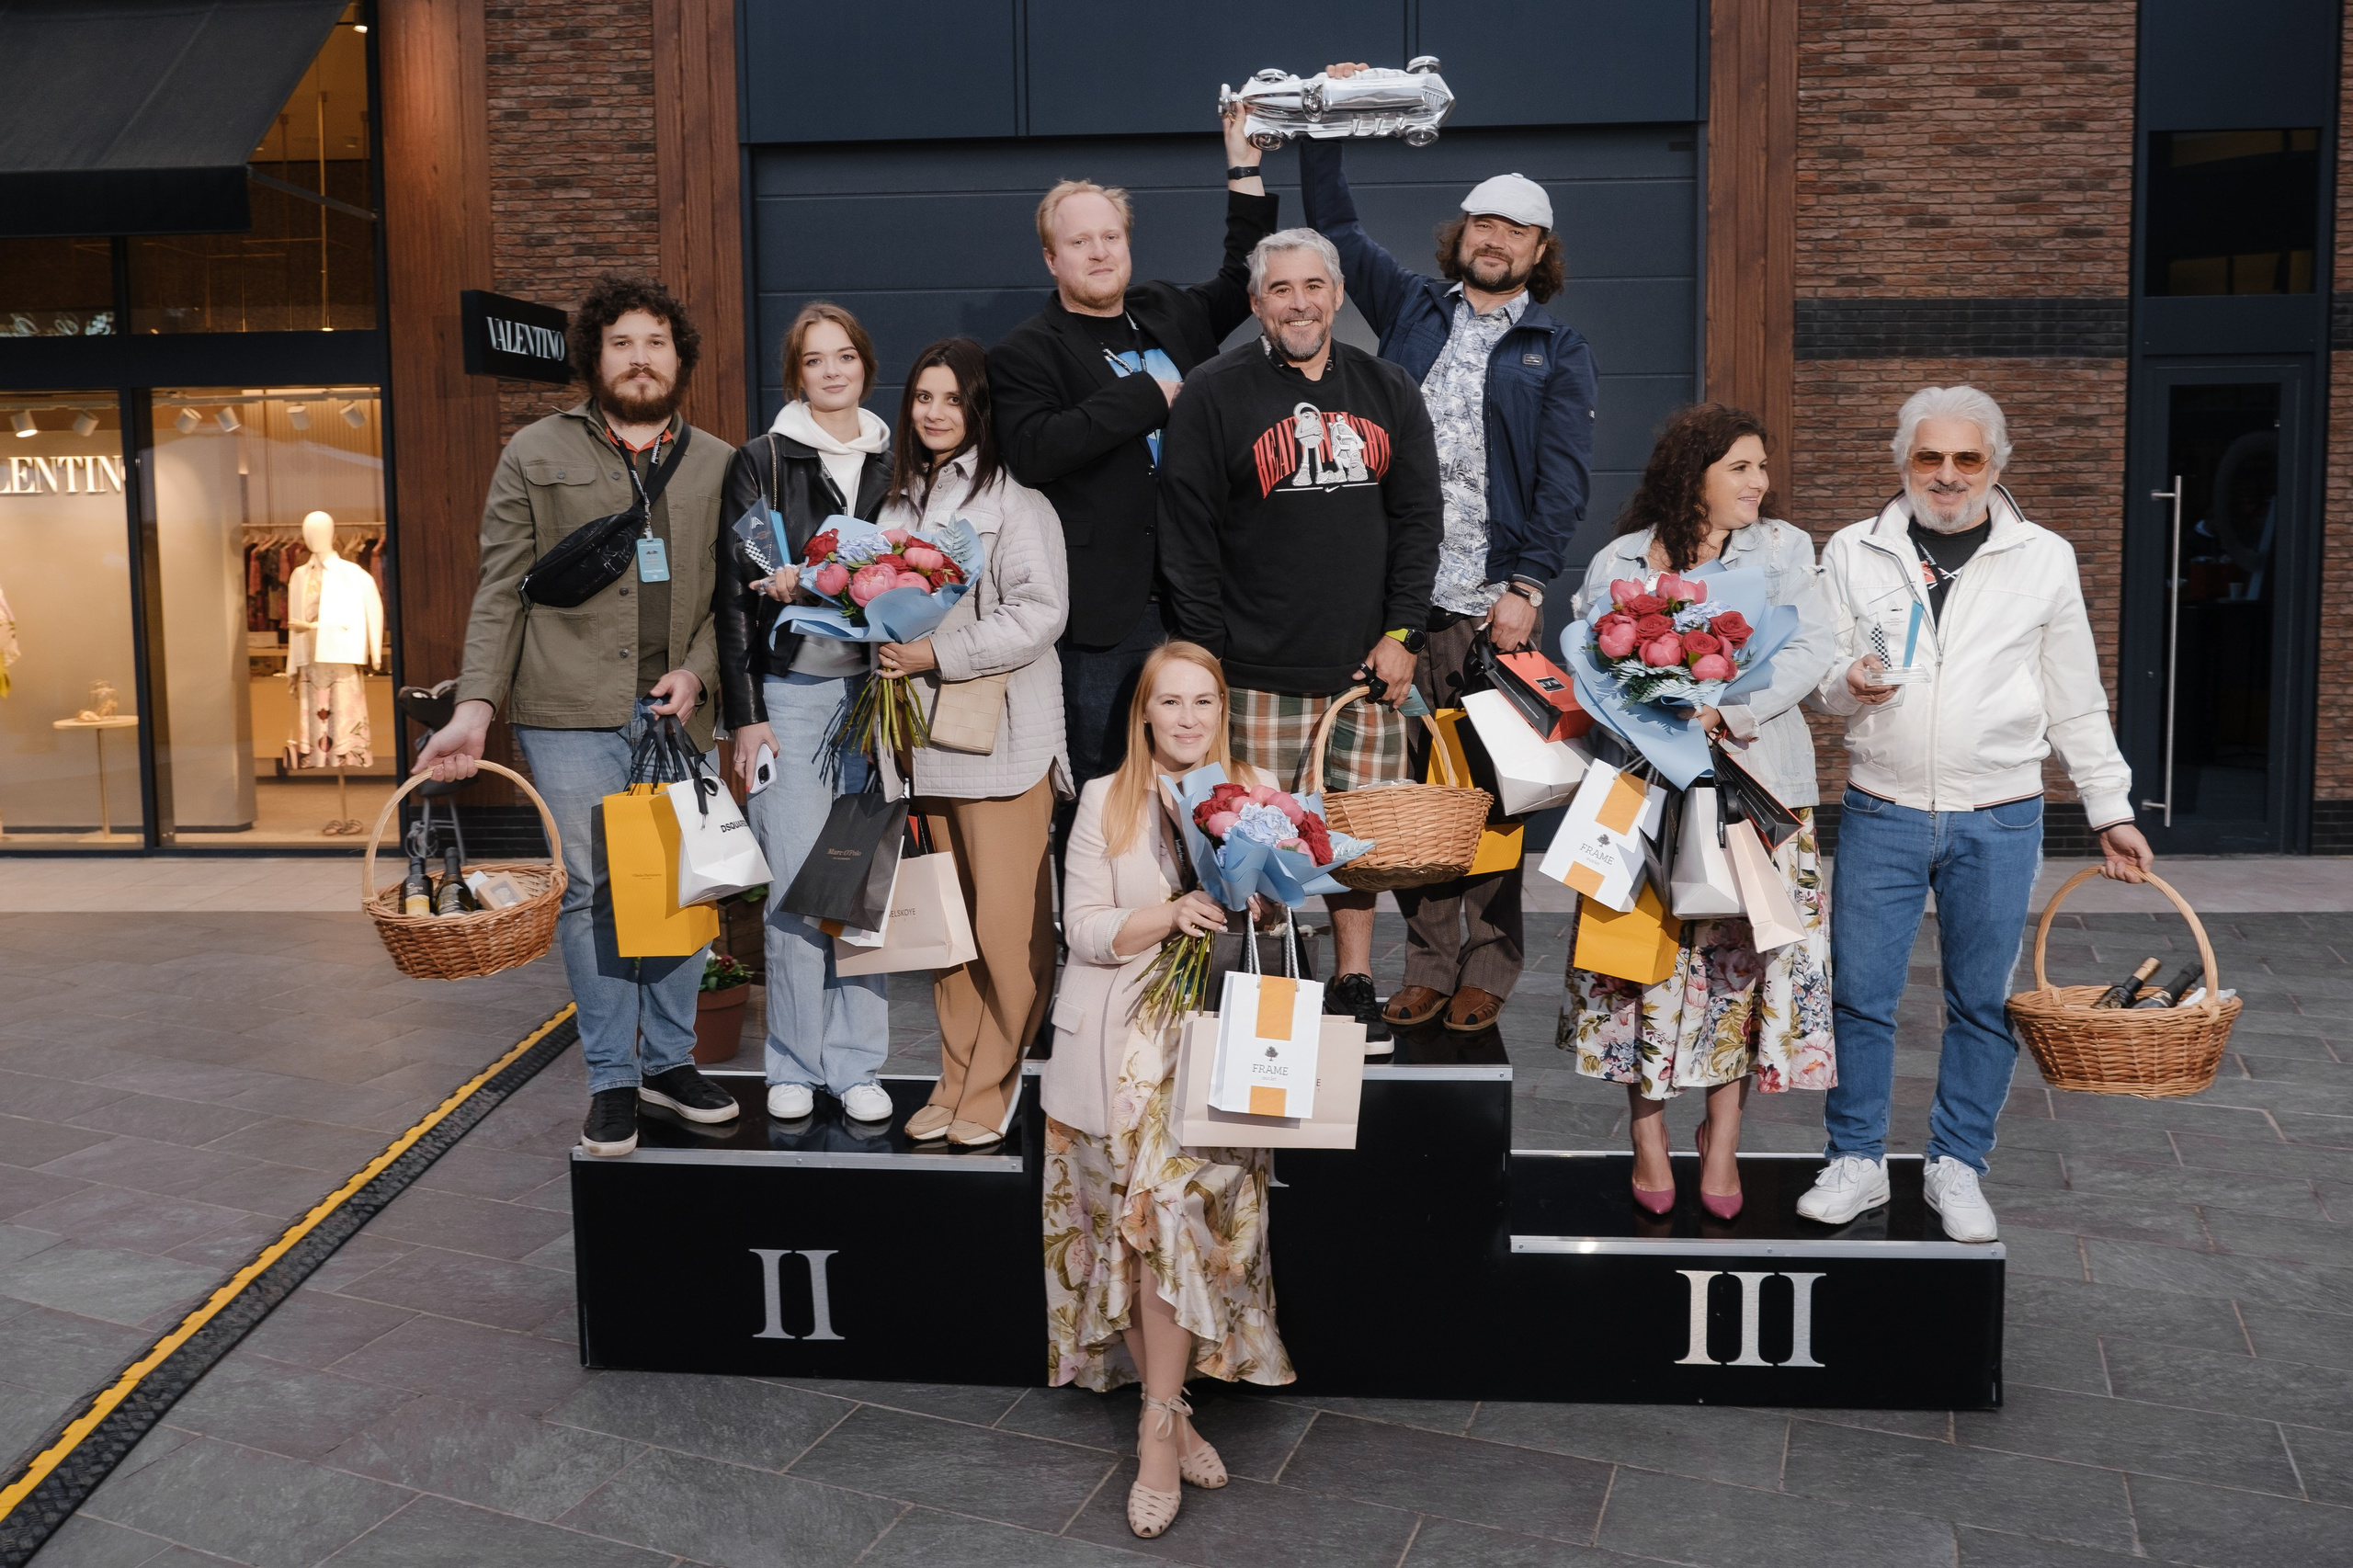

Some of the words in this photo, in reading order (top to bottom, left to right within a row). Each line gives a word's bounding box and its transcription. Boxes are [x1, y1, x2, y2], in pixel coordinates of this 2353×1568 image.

[486, 316, 565, 361] VALENTINO
[1580, 843, 1615, 865] FRAME
[1252, 1063, 1289, 1076] FRAME
[749, 1248, 846, 1340] II
[1674, 1269, 1827, 1367] III
